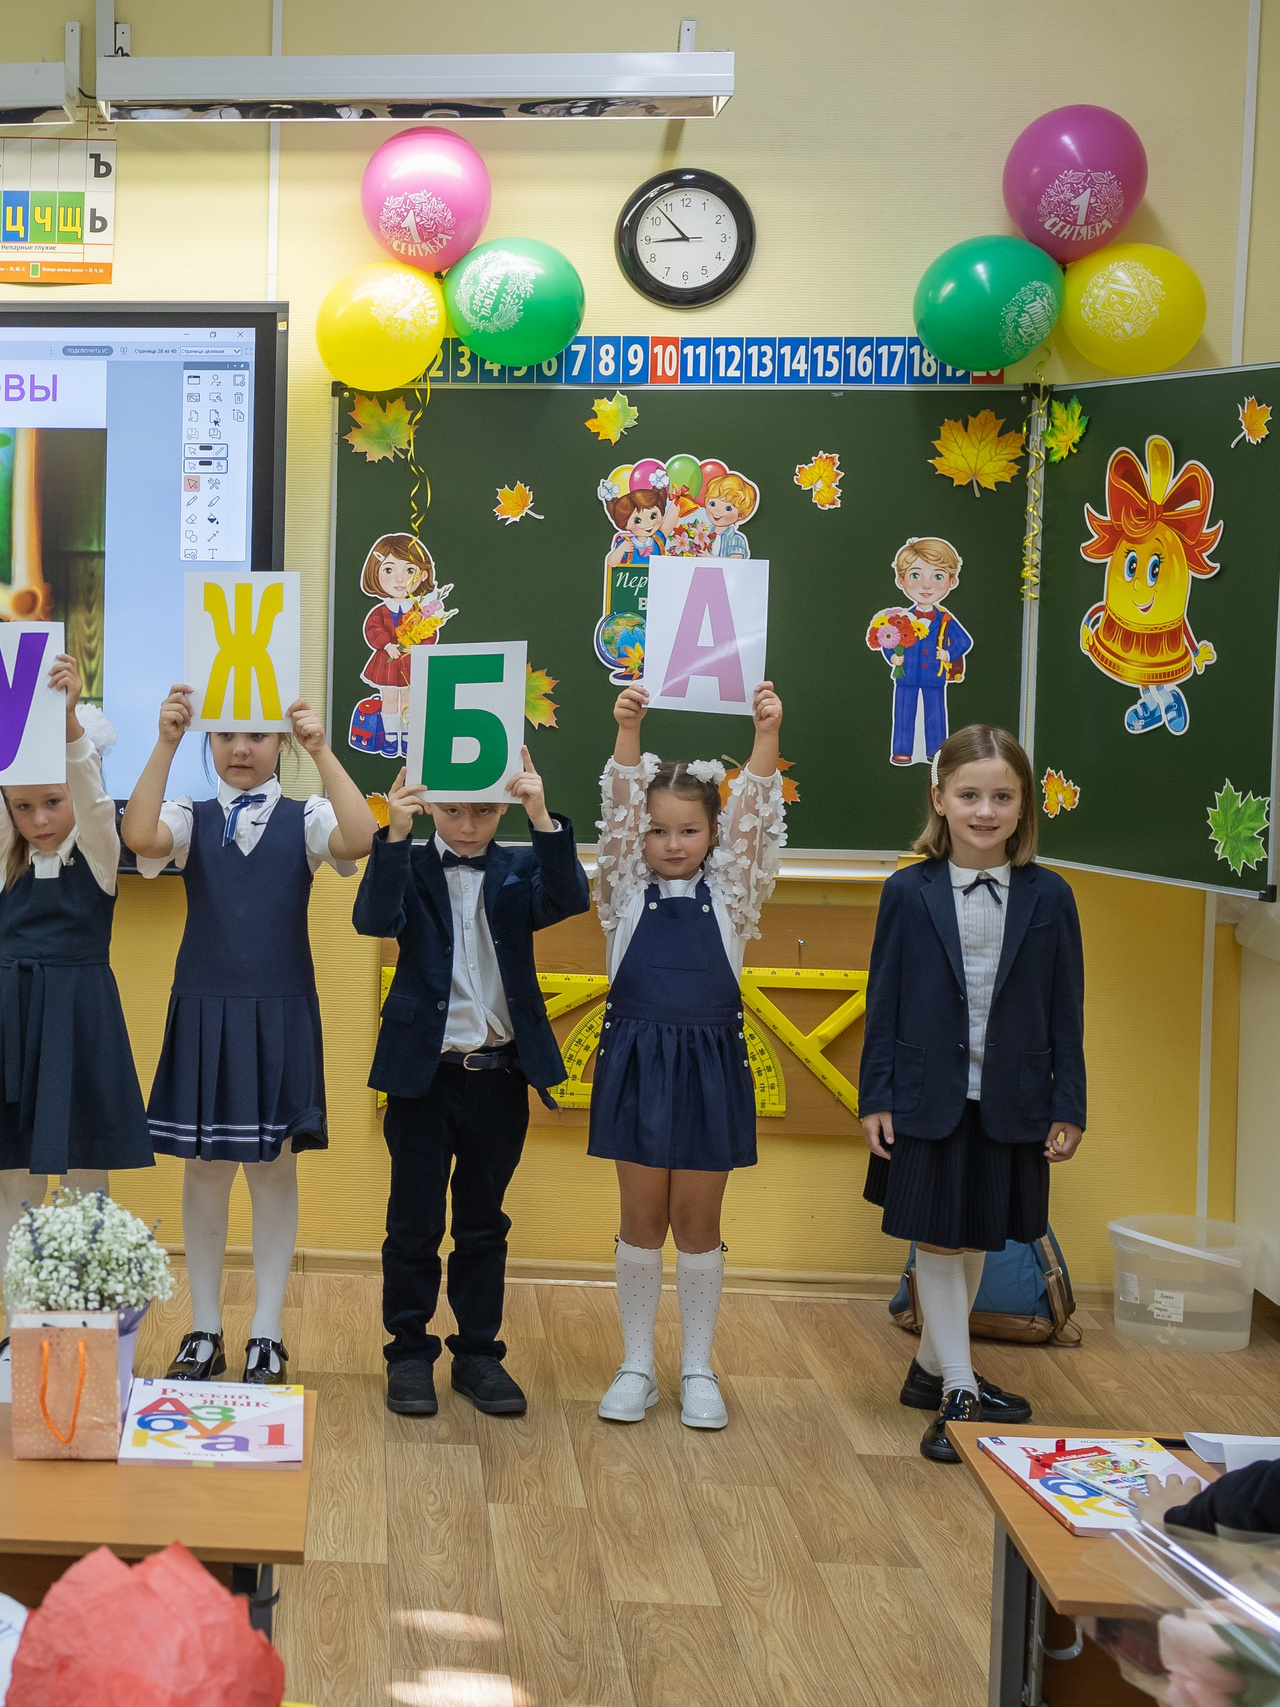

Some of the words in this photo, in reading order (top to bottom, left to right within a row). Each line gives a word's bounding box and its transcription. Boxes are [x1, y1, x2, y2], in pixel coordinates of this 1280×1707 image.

[664, 202, 673, 212] 11
[680, 198, 692, 208] 12
[702, 202, 706, 211] 1
[1070, 188, 1092, 226] 1
[6, 206, 25, 238] ц
[34, 206, 52, 232] ч
[58, 207, 82, 239] щ
[650, 216, 662, 226] 10
[715, 214, 722, 224] 2
[401, 210, 421, 243] 1
[1043, 217, 1113, 242] СЕНТЯБРЯ
[644, 235, 652, 245] 9
[720, 233, 727, 243] 3
[1, 244, 32, 252] Непарные
[392, 233, 452, 257] СЕНТЯБРЯ
[650, 253, 656, 263] 8
[715, 252, 722, 261] 4
[664, 266, 671, 276] 7
[701, 266, 708, 276] 5
[682, 272, 689, 282] 6
[134, 348, 157, 356] Страница
[182, 348, 204, 356] Страница
[457, 346, 472, 378] 3
[570, 344, 586, 376] 7
[598, 344, 615, 376] 8
[628, 344, 644, 376] 9
[653, 344, 677, 376] 10
[683, 345, 705, 376] 11
[715, 345, 741, 377] 12
[748, 345, 774, 377] 13
[780, 345, 808, 377] 14
[813, 345, 840, 377] 15
[845, 345, 872, 377] 16
[877, 345, 904, 377] 17
[909, 345, 937, 377] 18
[616, 572, 648, 596] Пер
[200, 582, 284, 720] Ж
[422, 654, 509, 792] Б
[660, 567, 746, 702] А
[161, 1388, 251, 1400] Русский
[258, 1423, 293, 1446] 1
